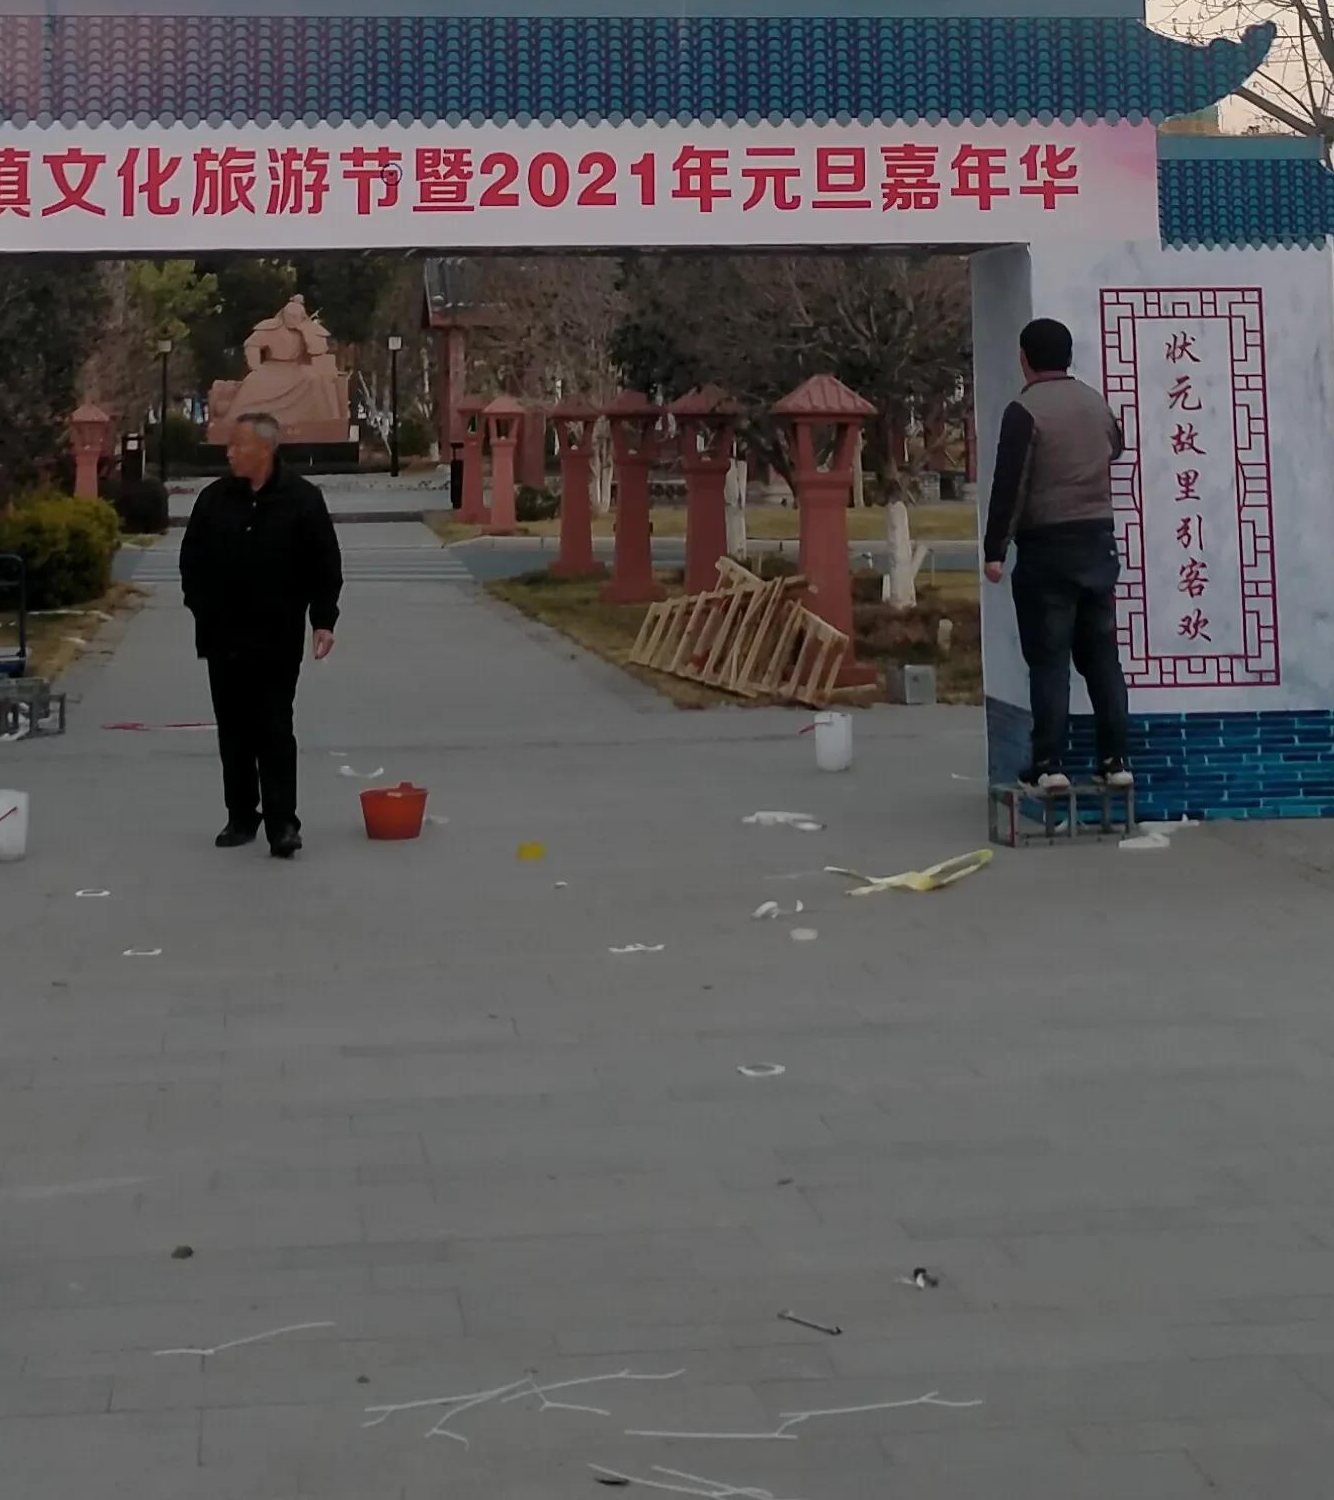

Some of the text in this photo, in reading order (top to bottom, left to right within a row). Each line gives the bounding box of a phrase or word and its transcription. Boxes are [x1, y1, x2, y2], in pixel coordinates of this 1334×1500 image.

[1165, 330, 1213, 643] 状元故里引客欢
